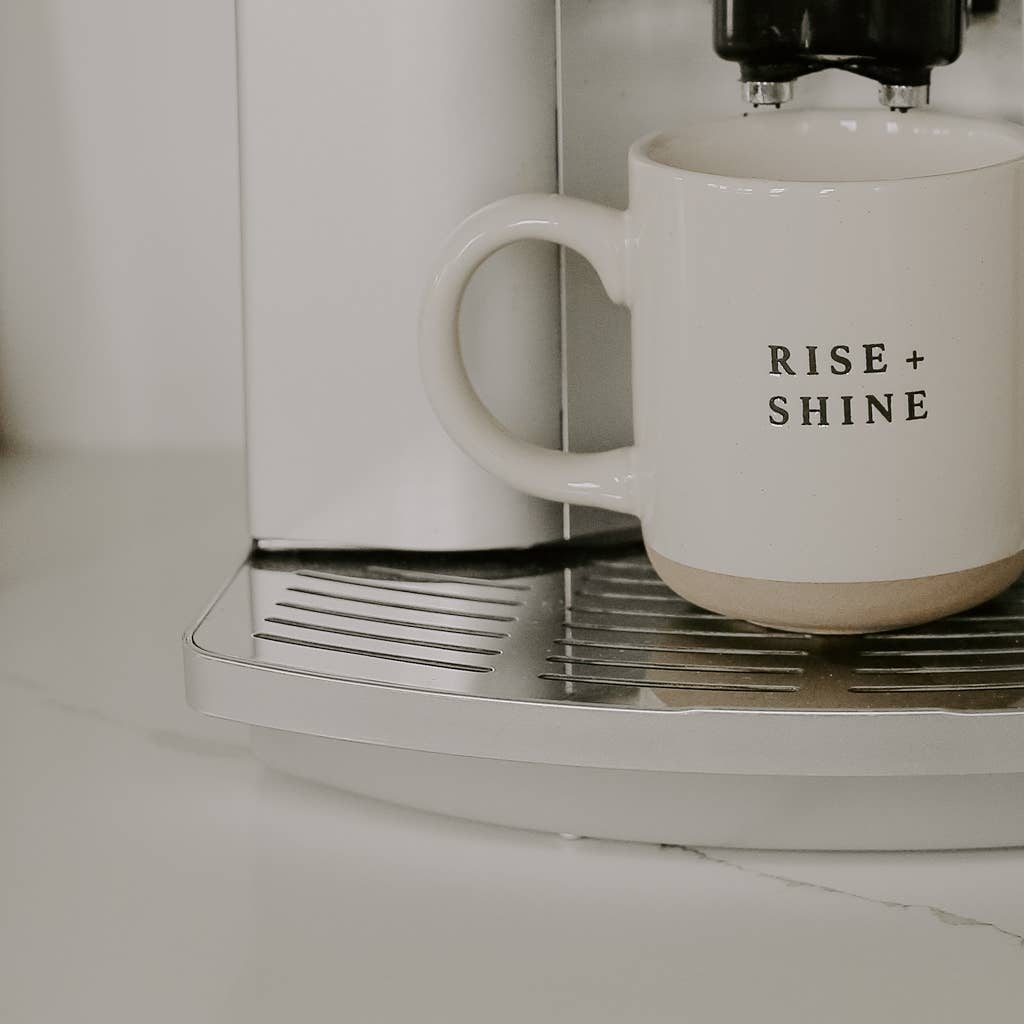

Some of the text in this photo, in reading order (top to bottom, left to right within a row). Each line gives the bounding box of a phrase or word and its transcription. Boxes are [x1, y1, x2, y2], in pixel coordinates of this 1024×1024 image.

[768, 343, 925, 375] RISE +
[768, 390, 928, 425] SHINE
